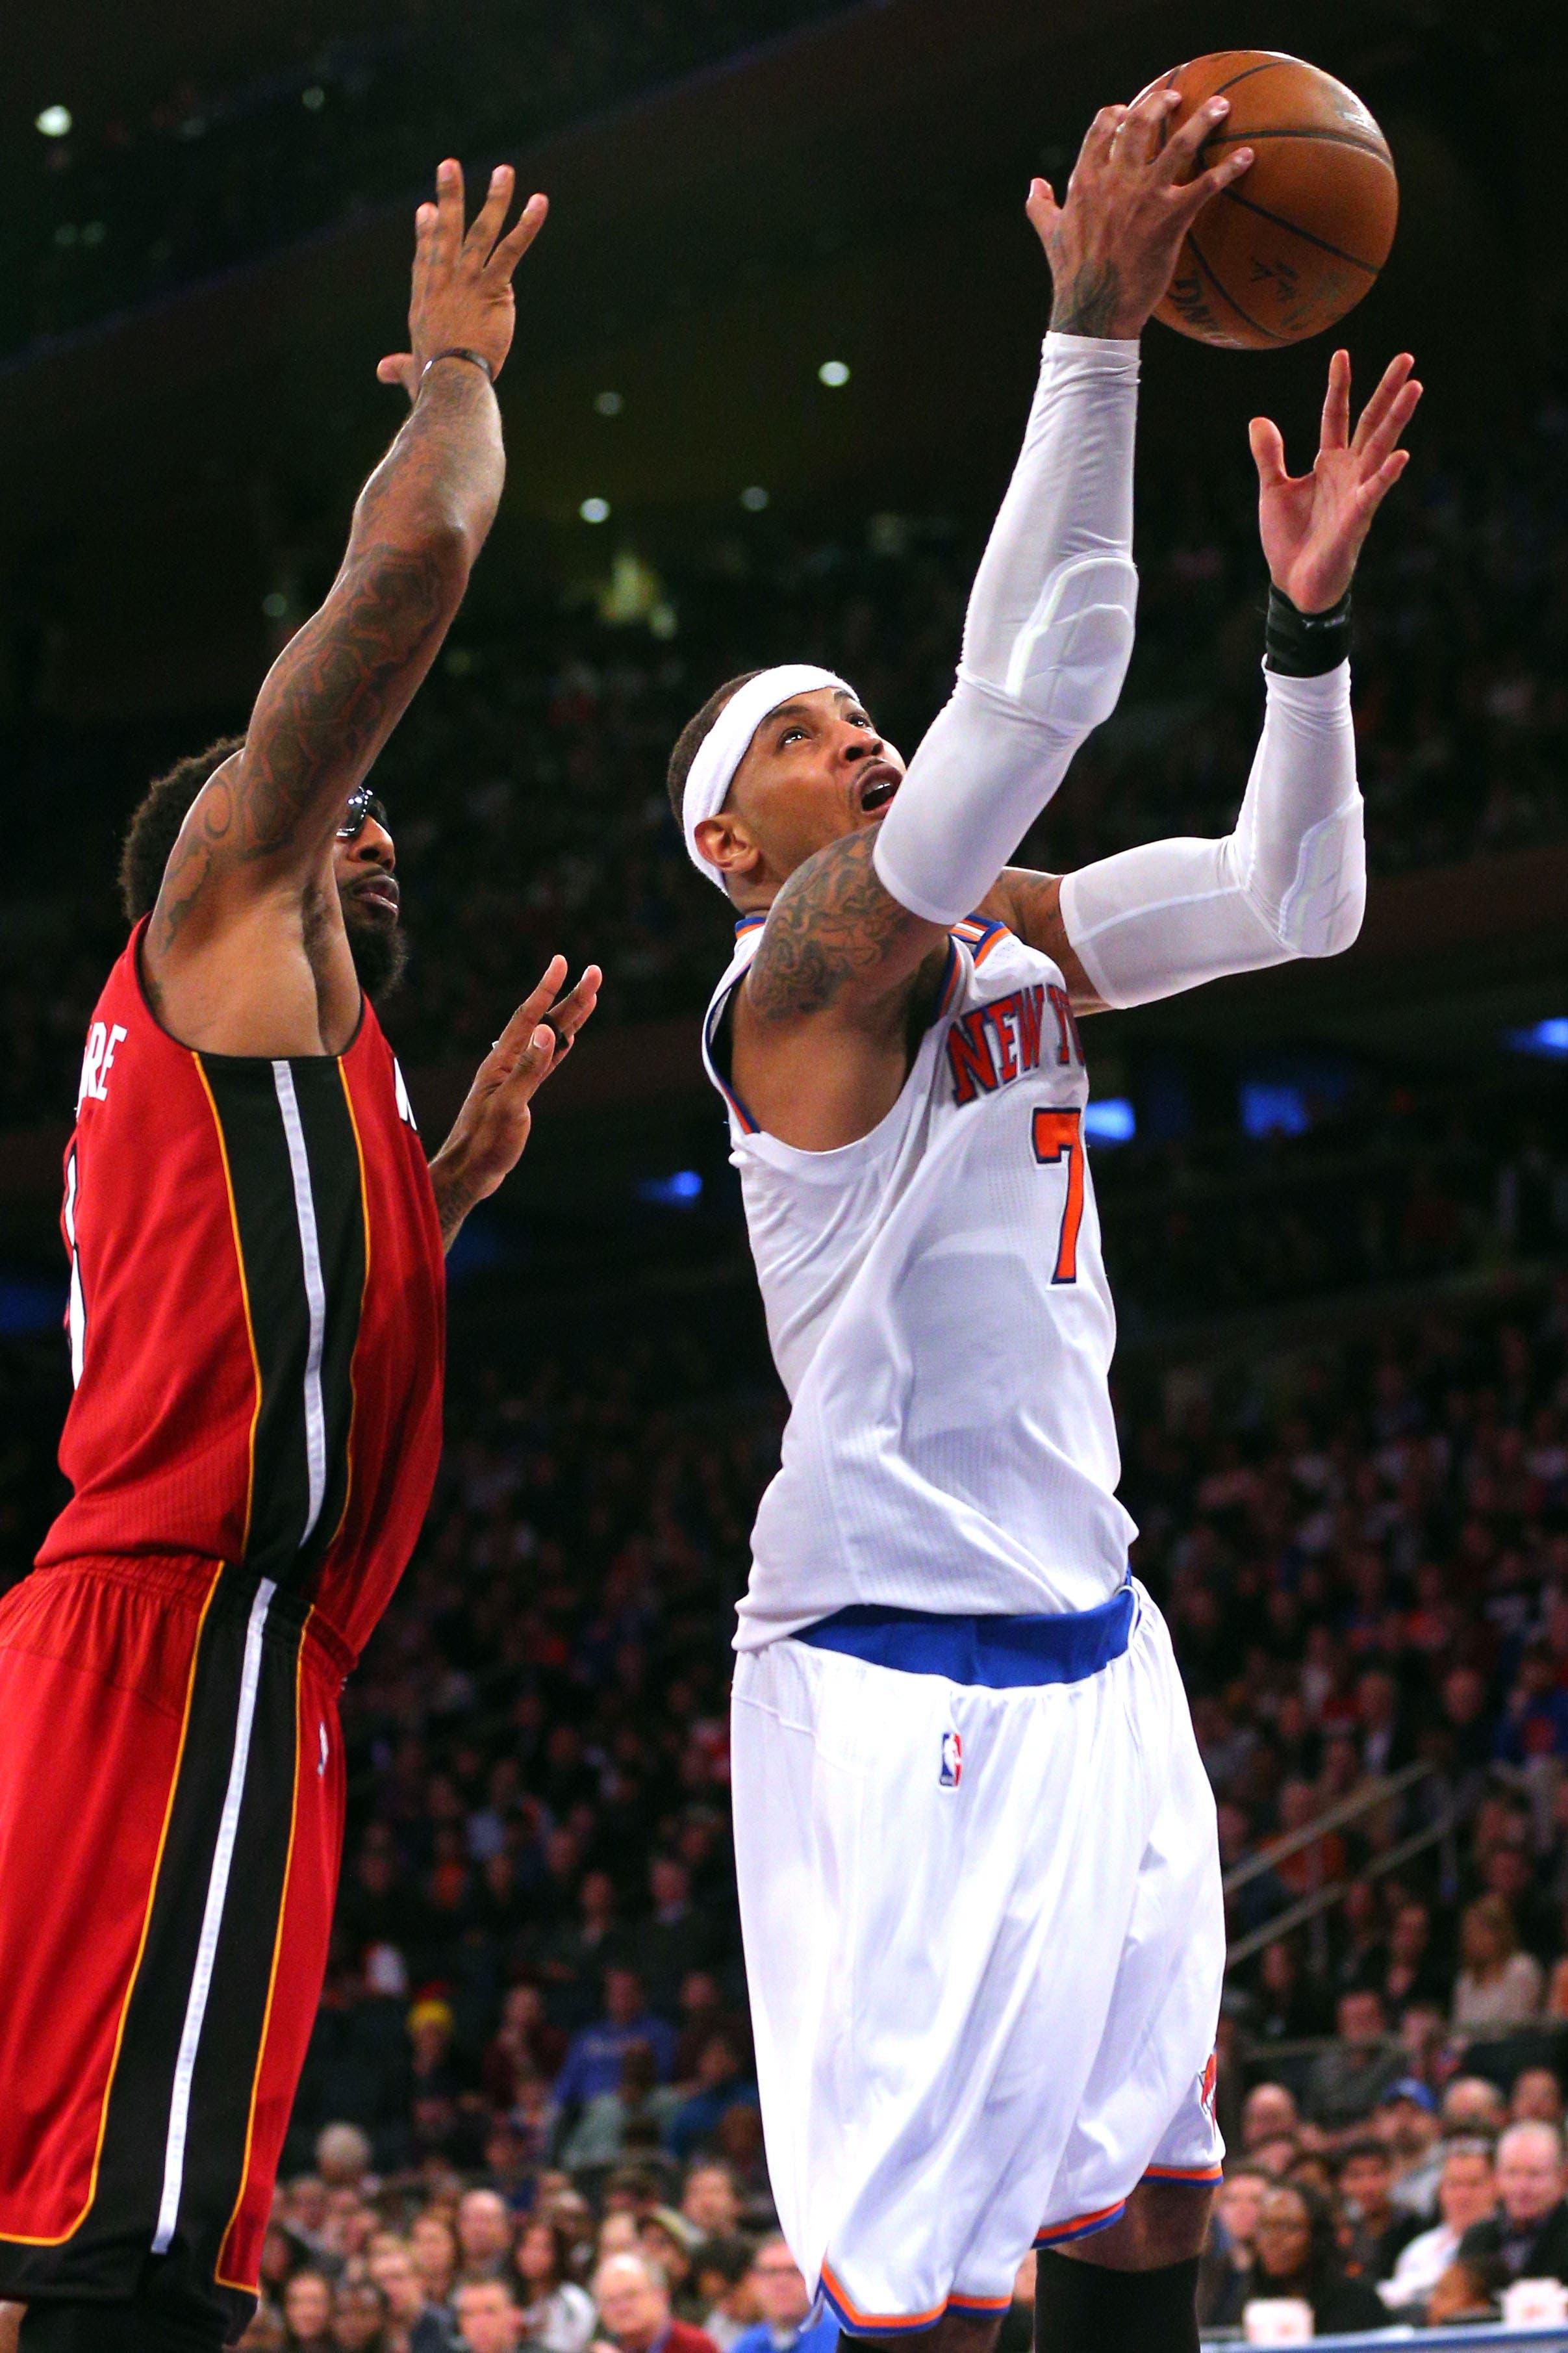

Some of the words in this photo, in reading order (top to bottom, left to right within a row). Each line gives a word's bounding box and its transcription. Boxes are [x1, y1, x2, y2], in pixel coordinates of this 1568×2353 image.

[79, 1021, 128, 1103] RE
[946, 984, 1044, 1106] NEW
[1046, 982, 1085, 1067] Y
[1033, 1107, 1085, 1284] 7
